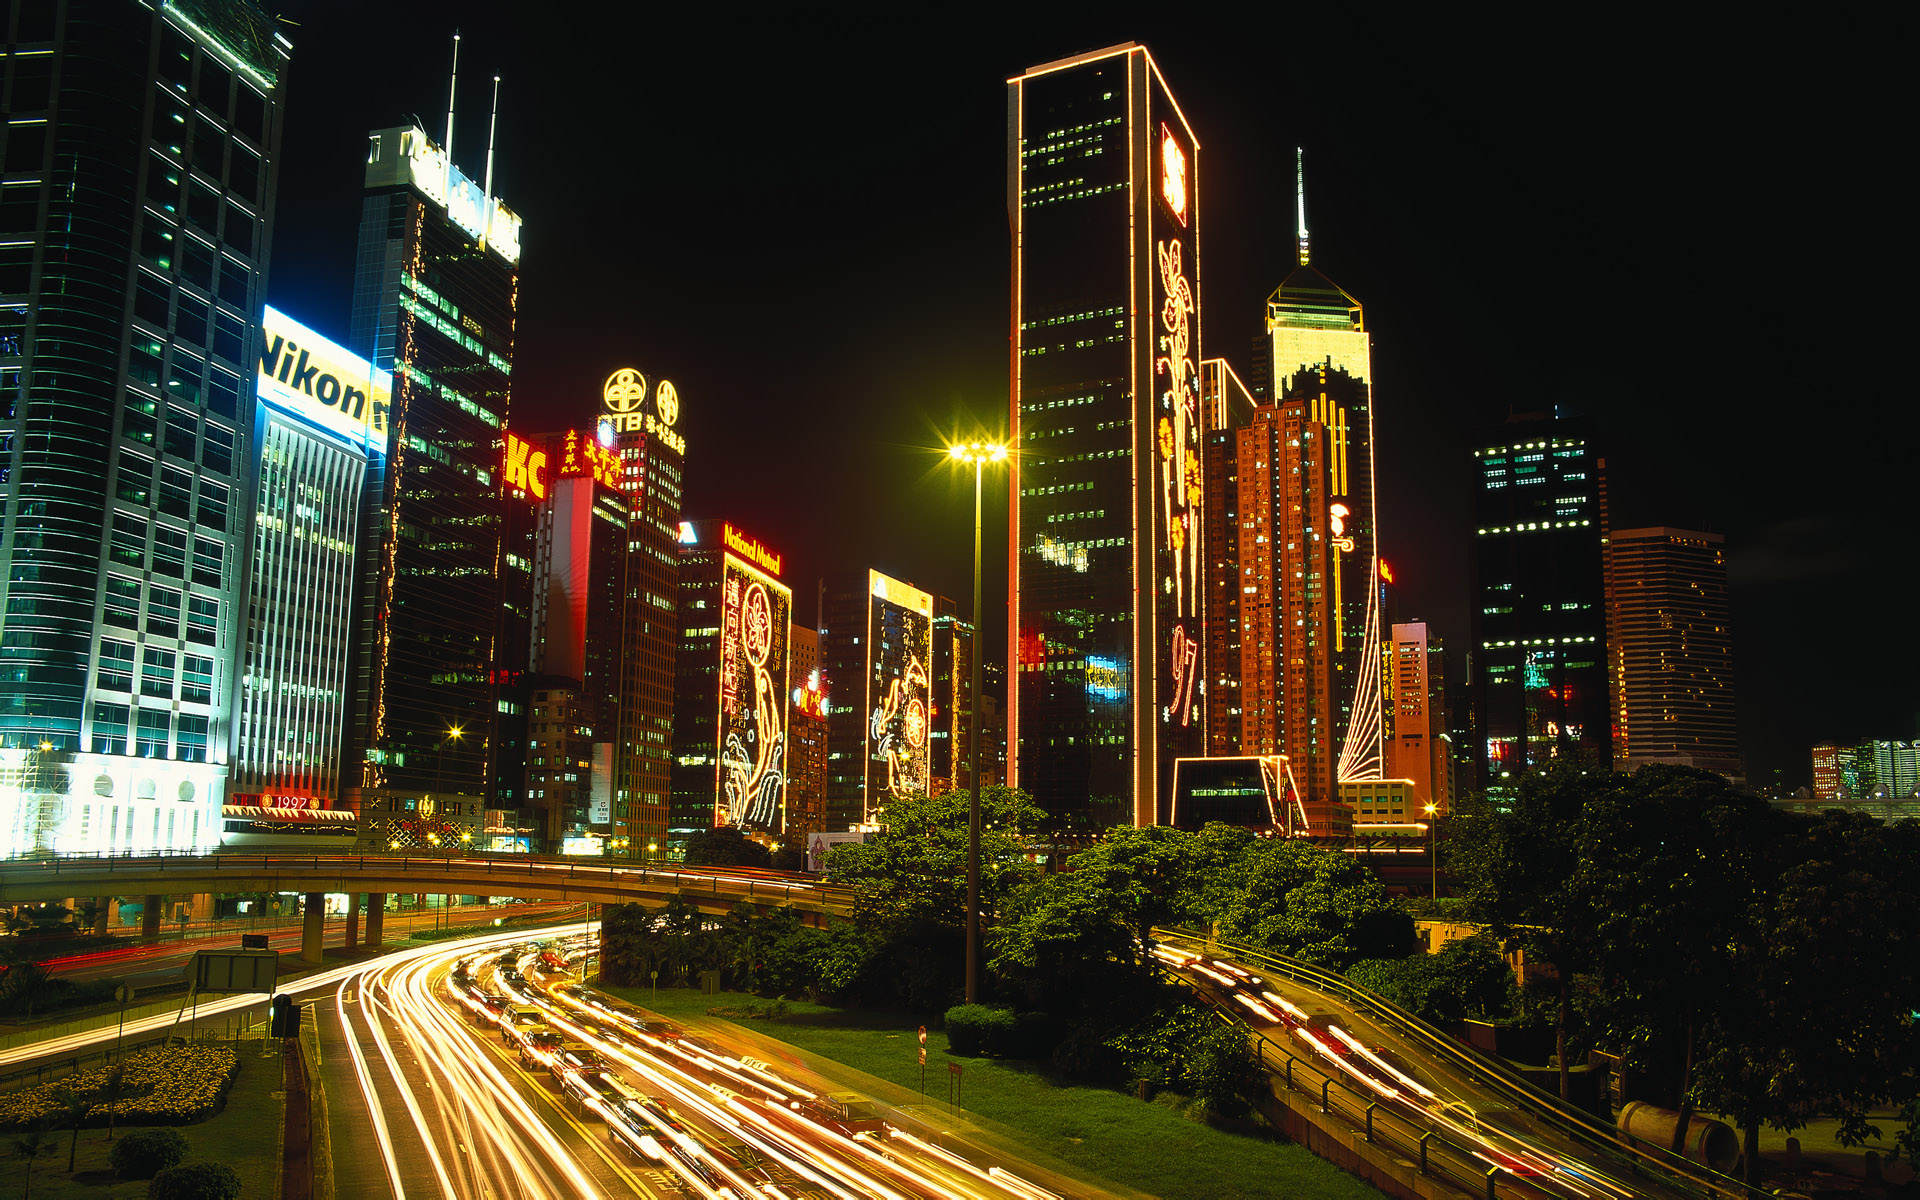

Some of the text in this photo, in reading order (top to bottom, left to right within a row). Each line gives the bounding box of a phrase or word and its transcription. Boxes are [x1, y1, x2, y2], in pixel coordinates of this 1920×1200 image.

[261, 327, 366, 420] Nikon
[505, 434, 547, 499] KC
[724, 523, 780, 575] National Mutual
[1170, 625, 1198, 727] 97
[277, 796, 307, 811] 1997
